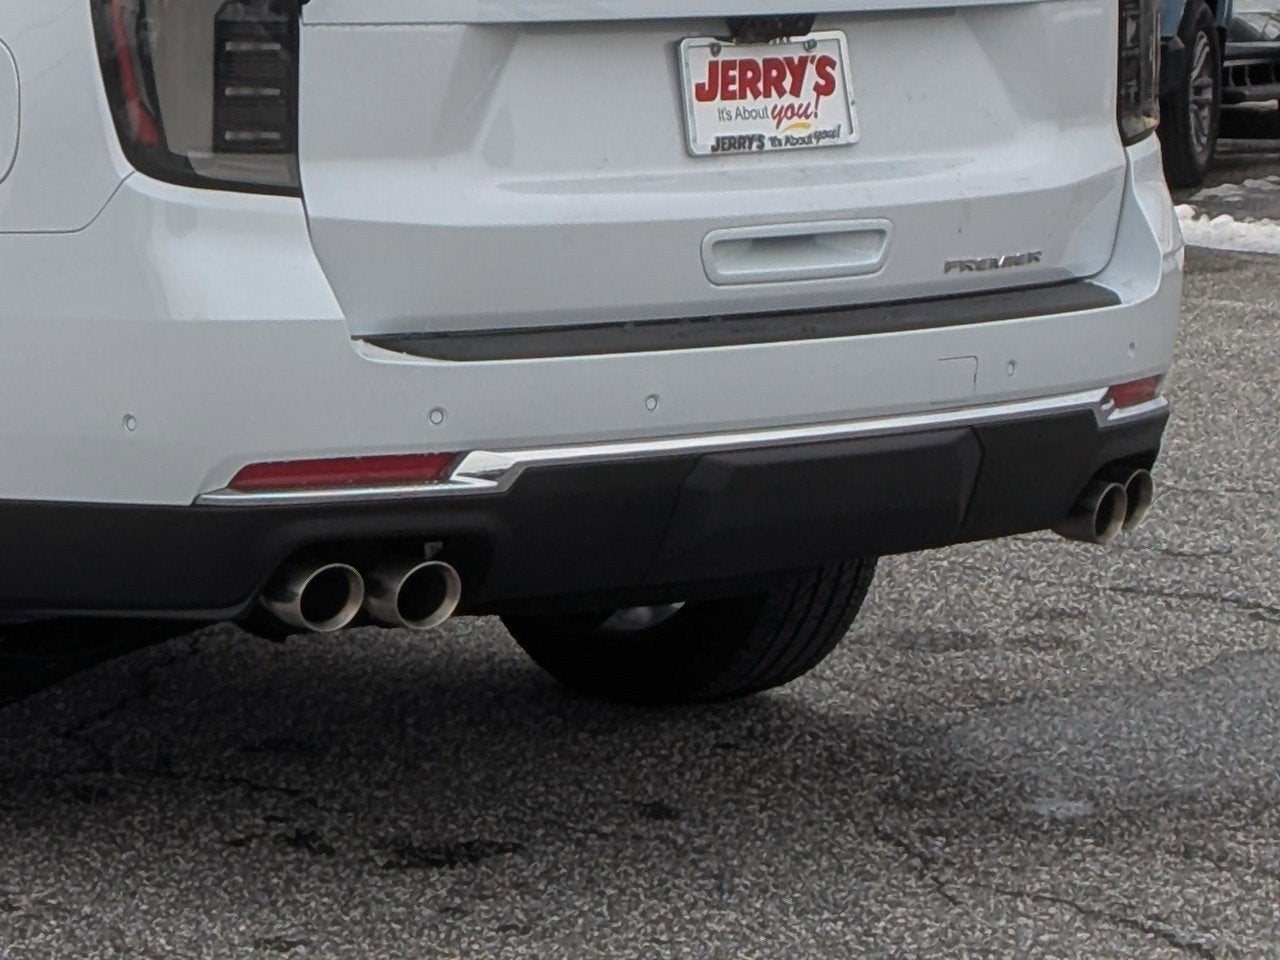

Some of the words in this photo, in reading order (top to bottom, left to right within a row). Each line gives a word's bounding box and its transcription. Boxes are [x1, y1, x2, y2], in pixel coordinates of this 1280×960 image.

[695, 55, 837, 102] JERRY'S
[734, 105, 769, 121] About
[771, 95, 819, 130] you!
[711, 134, 766, 152] JERRY'S
[784, 135, 813, 147] About
[944, 250, 1042, 274] PREMIER
